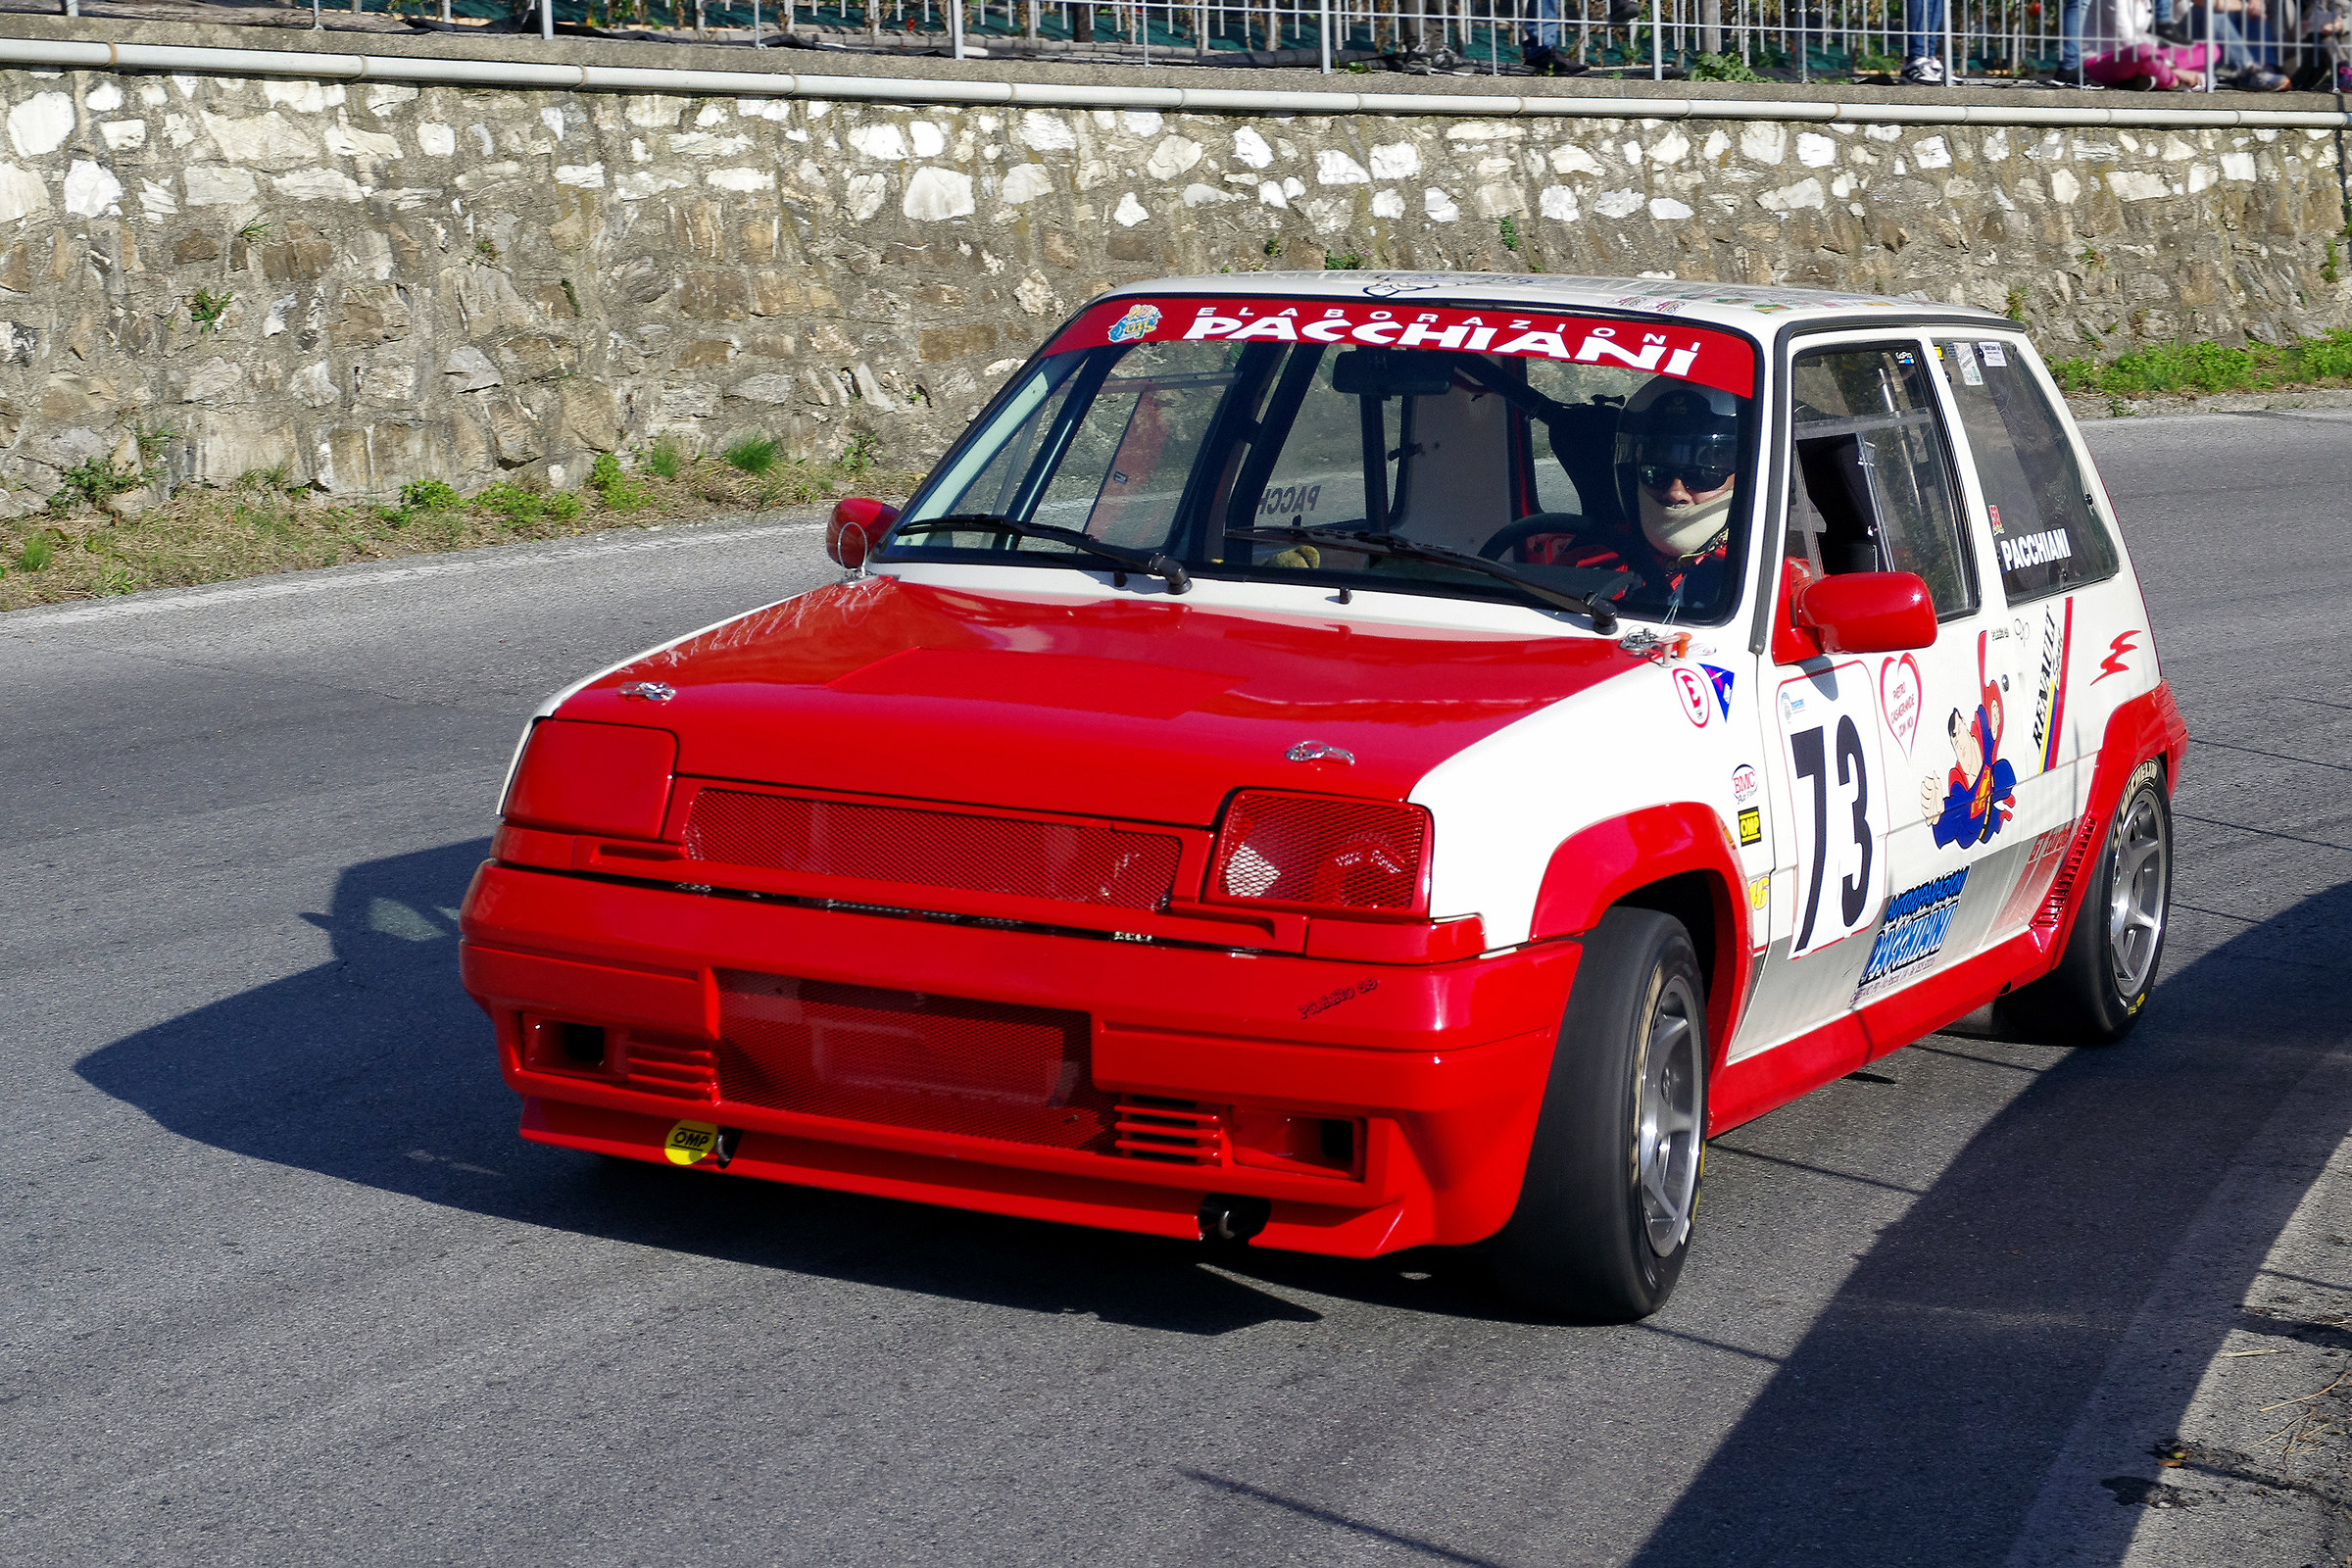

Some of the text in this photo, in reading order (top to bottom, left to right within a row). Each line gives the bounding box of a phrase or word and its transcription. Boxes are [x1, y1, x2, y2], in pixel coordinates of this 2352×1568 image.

[1183, 316, 1698, 376] PACCHIANI
[1196, 306, 1701, 353] ELABORAZIONI
[1999, 527, 2072, 571] PACCHIANI
[2033, 603, 2055, 755] RENAULT
[1733, 771, 1756, 795] BMC
[1740, 815, 1760, 837] OMP
[1789, 714, 1873, 953] 73
[1858, 899, 1960, 988] PACCHIANI
[674, 1131, 710, 1148] OMP
